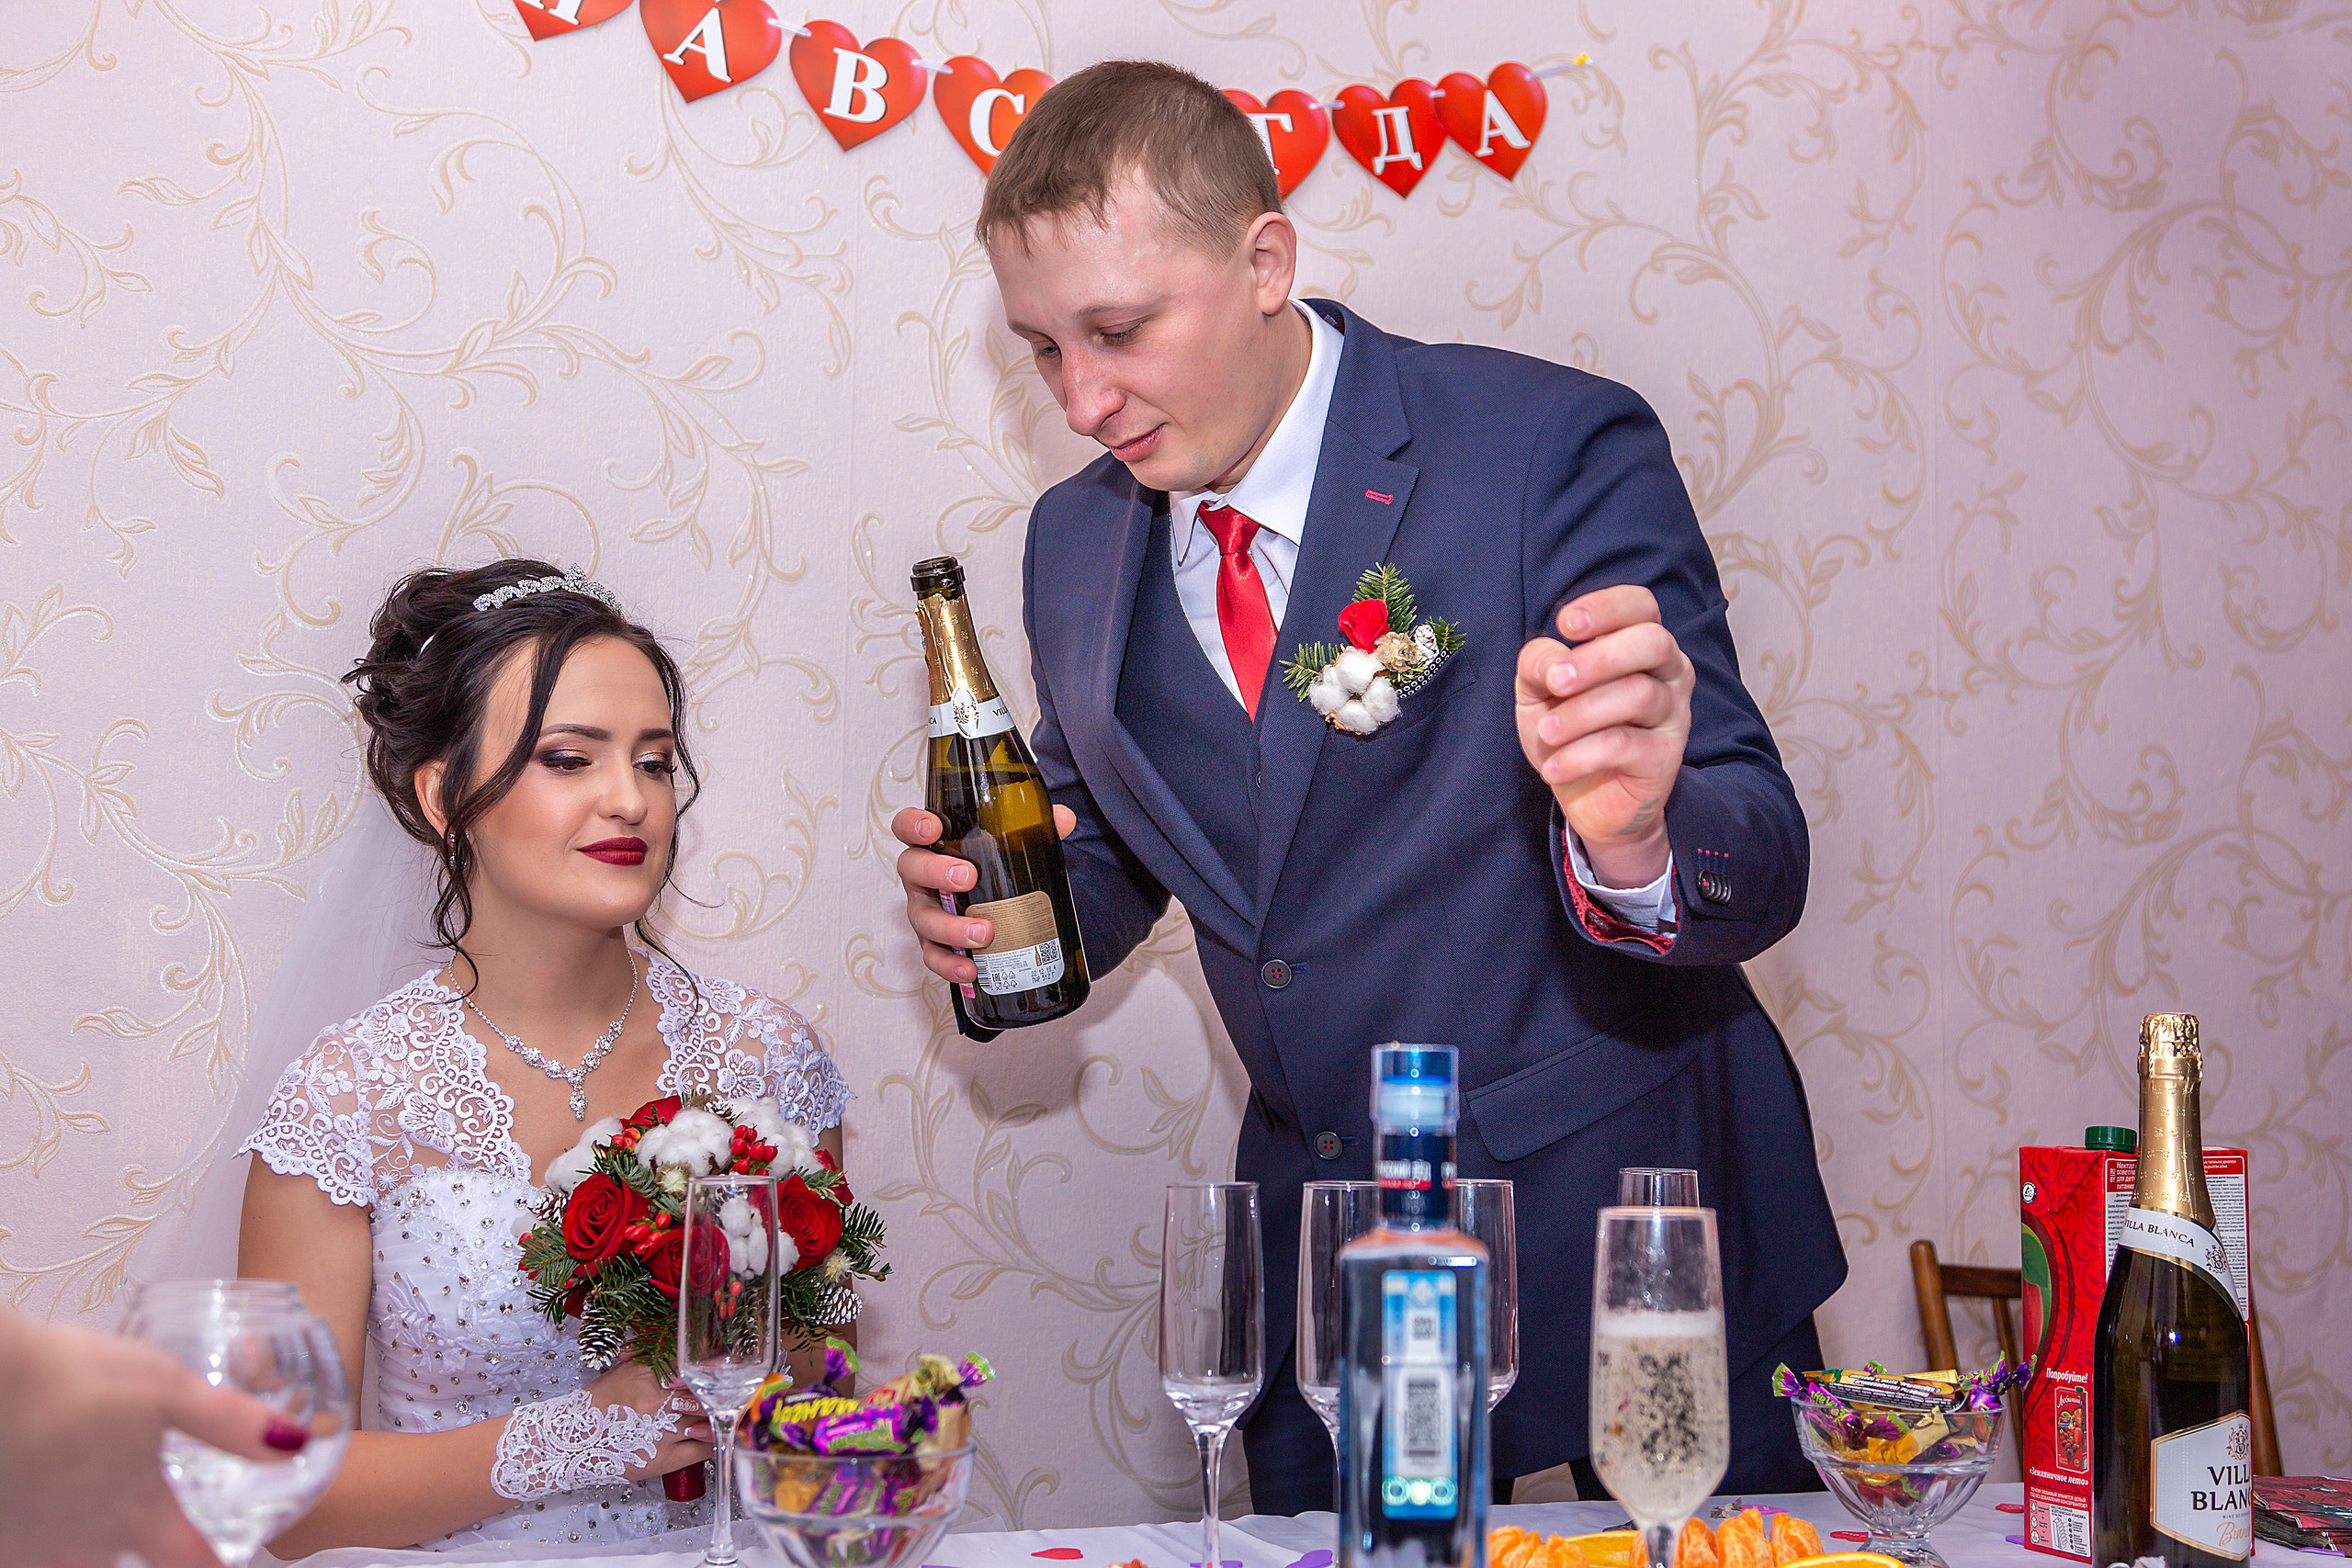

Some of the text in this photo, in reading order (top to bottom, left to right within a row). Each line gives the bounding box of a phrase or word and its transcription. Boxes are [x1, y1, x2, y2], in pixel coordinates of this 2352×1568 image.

[992, 706, 1008, 716] VILL
[2147, 1224, 2194, 1247] BLANCA
[2046, 1368, 2088, 1383] Попробуйте!
[2067, 1476, 2089, 1486] лето»
[2207, 1463, 2251, 1485] VILL
[2190, 1486, 2251, 1511] BLAN
